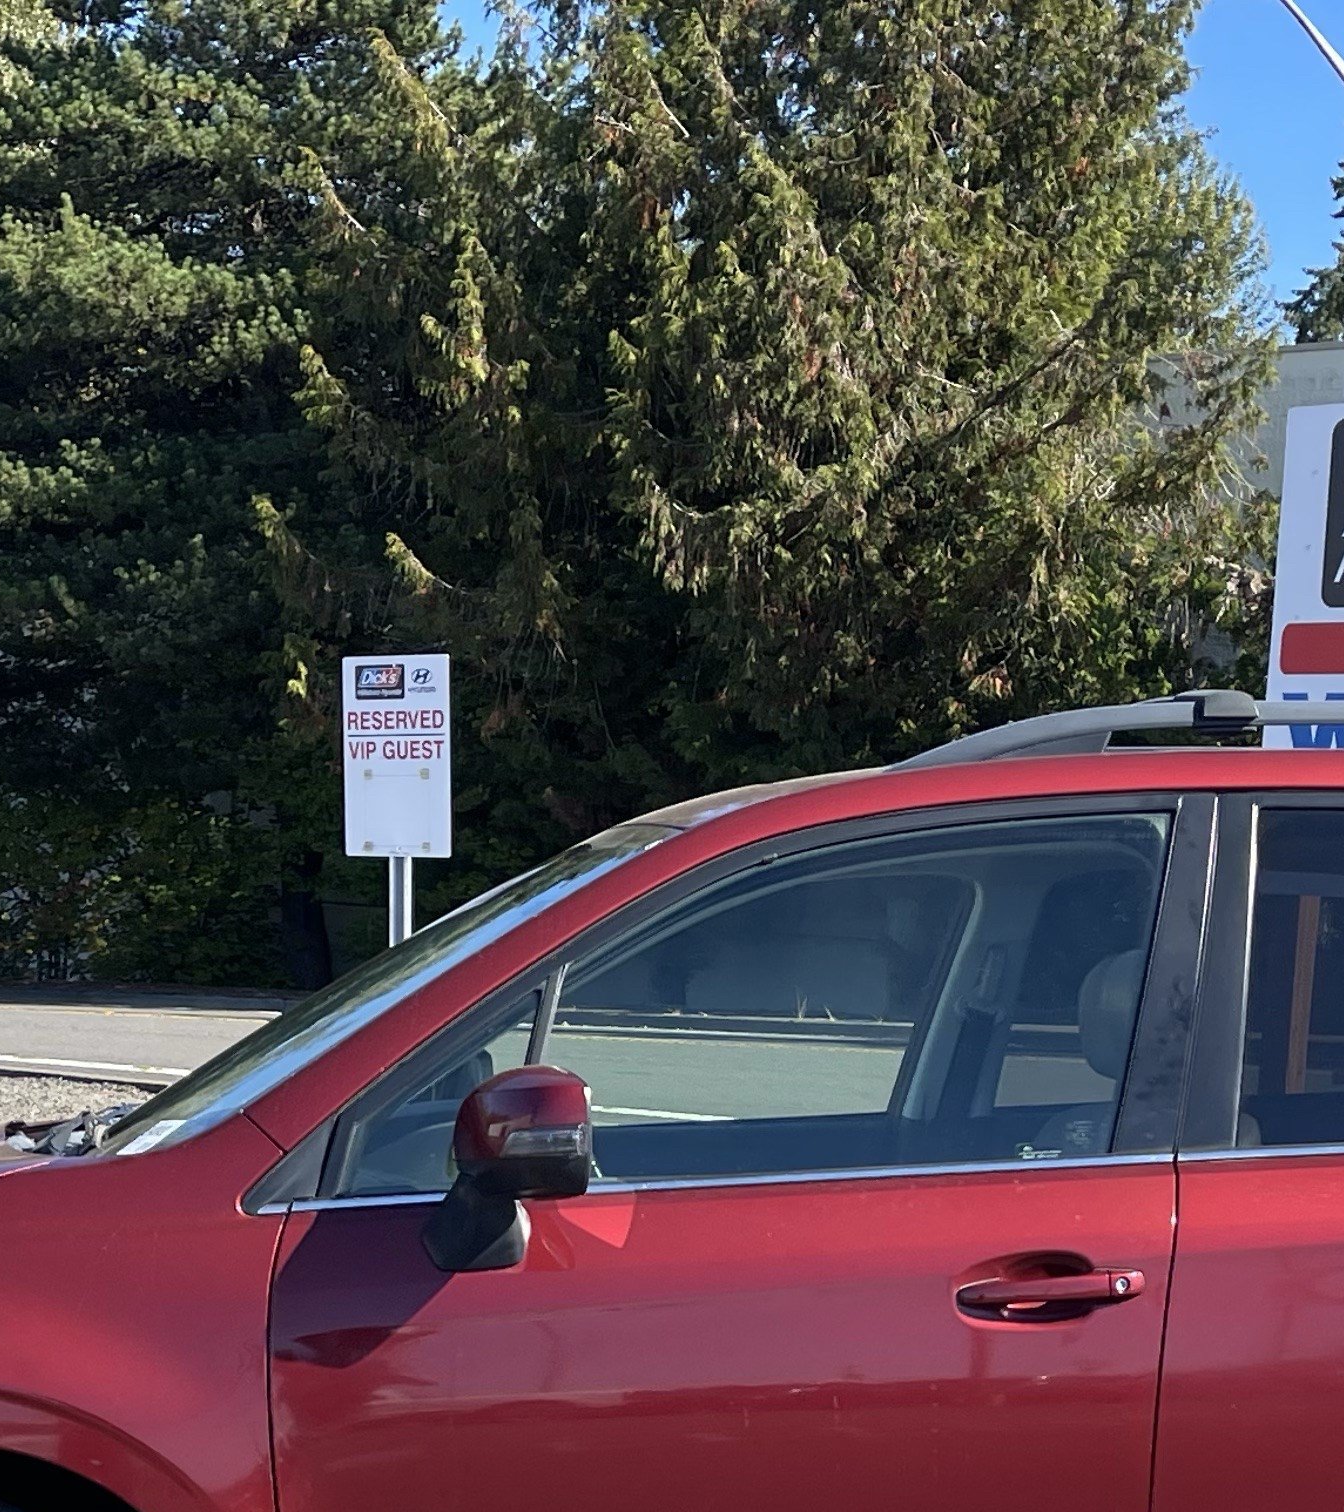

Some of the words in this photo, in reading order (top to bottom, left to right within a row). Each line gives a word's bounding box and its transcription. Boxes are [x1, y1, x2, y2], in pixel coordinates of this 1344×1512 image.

[347, 709, 444, 730] RESERVED
[348, 741, 376, 760] VIP
[382, 740, 445, 760] GUEST
